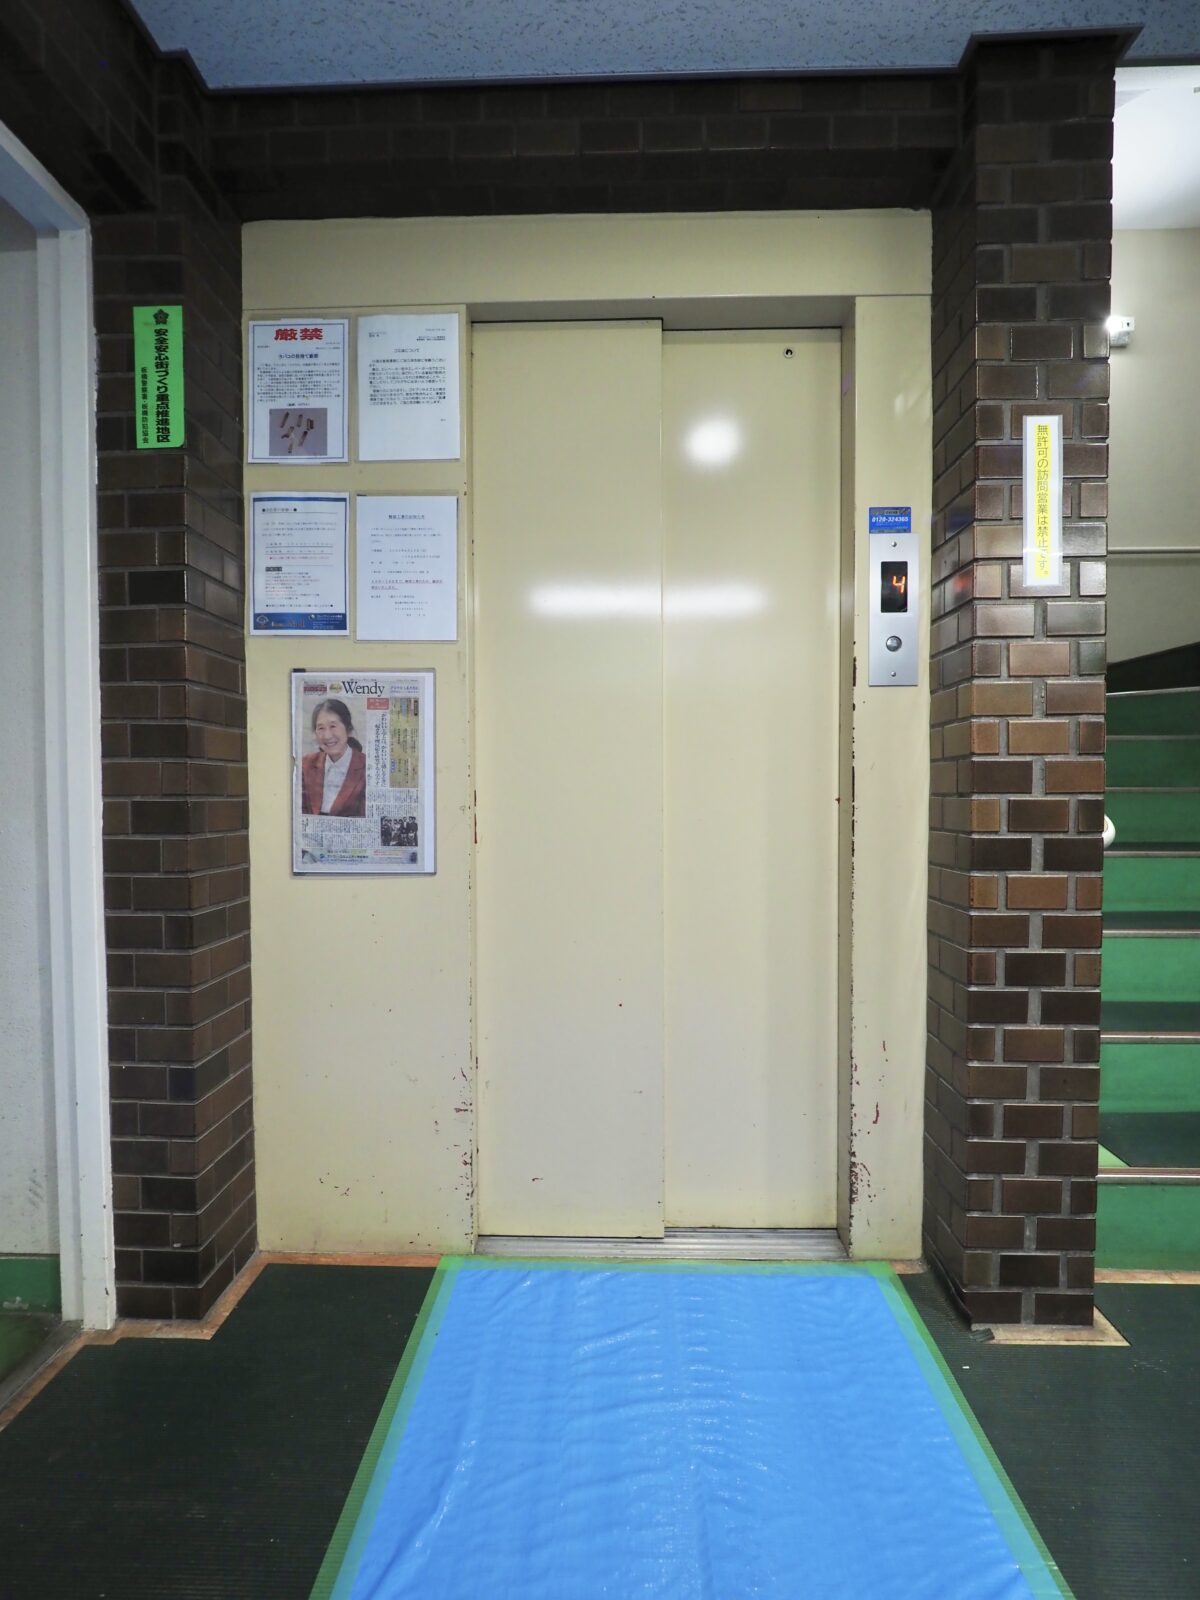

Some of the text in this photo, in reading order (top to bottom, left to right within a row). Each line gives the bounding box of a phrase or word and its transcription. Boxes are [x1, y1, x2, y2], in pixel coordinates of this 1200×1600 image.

[275, 327, 323, 341] 厳禁
[154, 328, 170, 443] 安全安心街づくり重点推進地区
[892, 575, 906, 593] 4
[342, 680, 385, 698] Wendy
